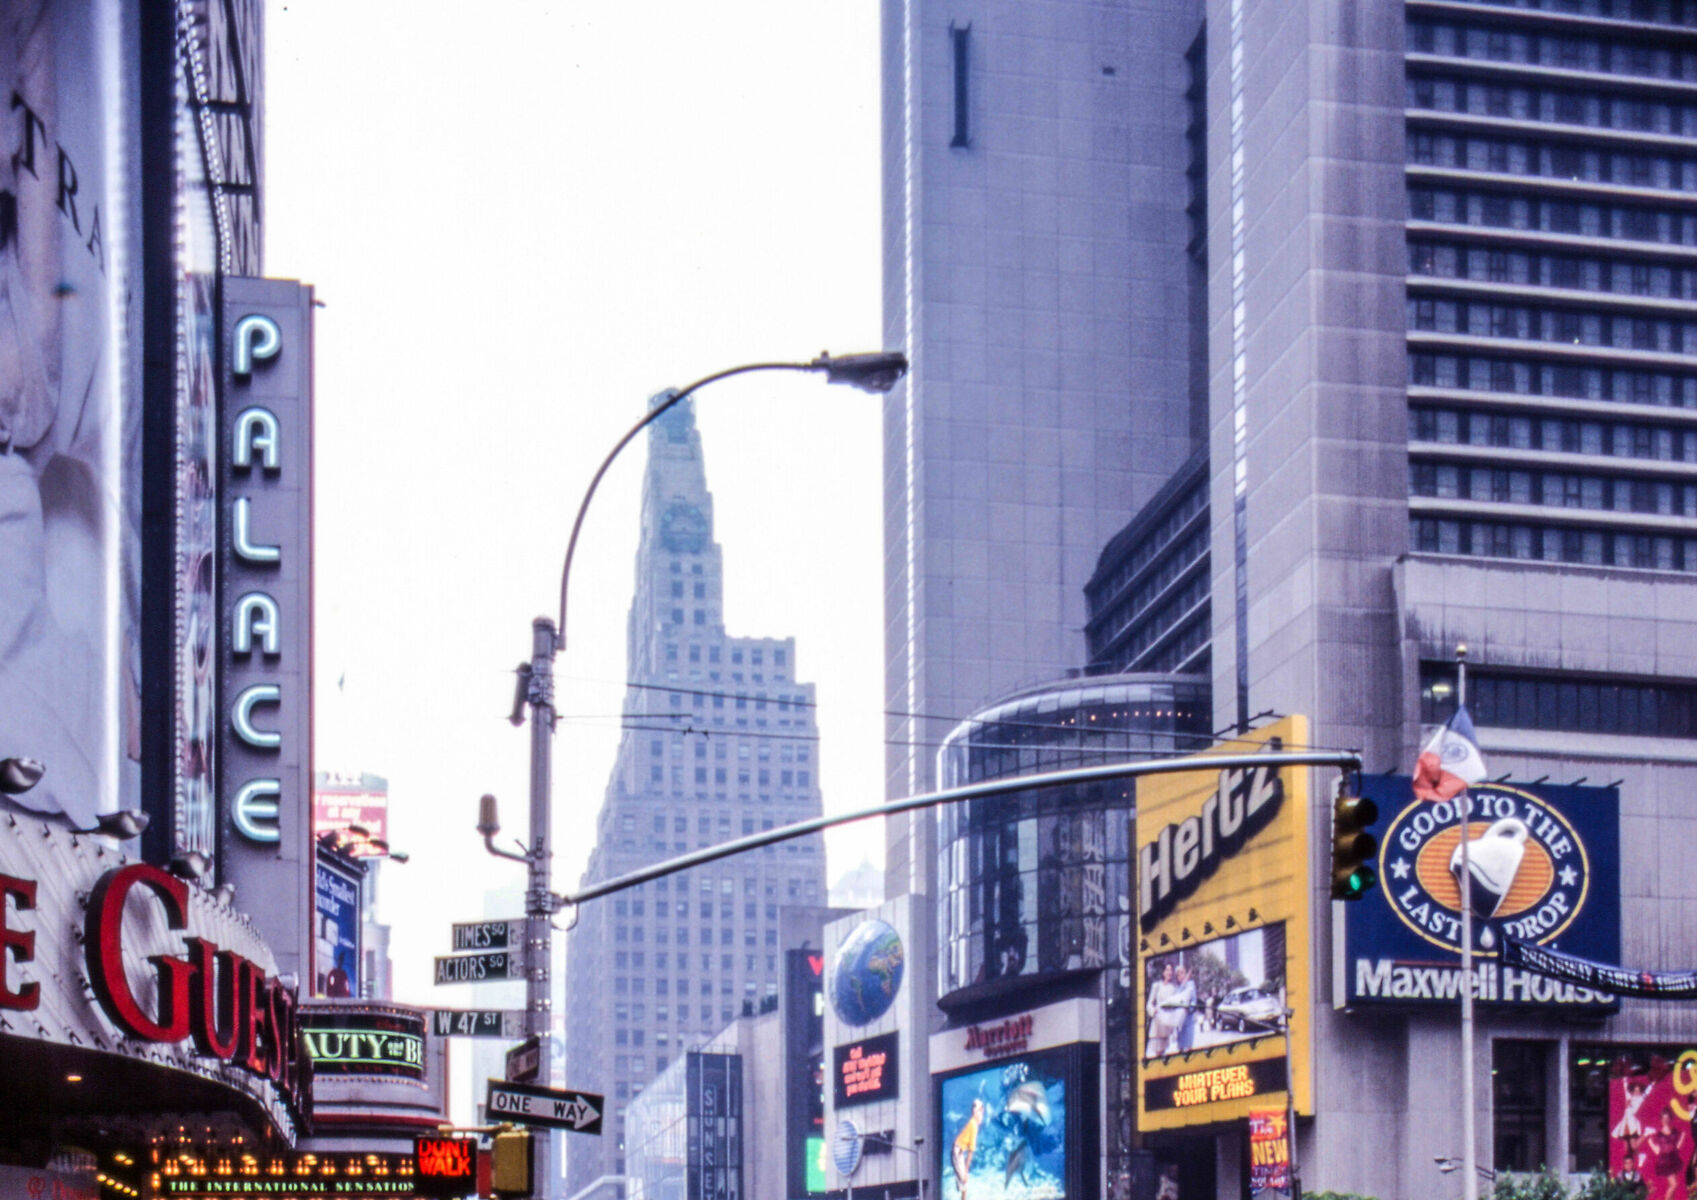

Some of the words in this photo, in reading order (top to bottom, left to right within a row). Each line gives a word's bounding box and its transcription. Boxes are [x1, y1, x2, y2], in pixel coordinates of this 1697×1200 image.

[232, 314, 283, 843] PALACE
[1140, 738, 1278, 919] Hertz
[1400, 796, 1474, 851] GOOD
[1477, 795, 1516, 817] TO
[1524, 804, 1572, 859] THE
[1399, 885, 1463, 940] LAST
[1503, 891, 1570, 939] DROP
[454, 924, 491, 948] TIMES
[492, 923, 505, 936] SQ
[437, 956, 486, 982] ACTORS
[489, 955, 504, 968] SQ
[439, 1013, 451, 1034] W
[458, 1012, 478, 1035] 47
[484, 1012, 498, 1025] ST
[1178, 1065, 1248, 1090] WHATEVER
[496, 1093, 532, 1113] ONE
[553, 1101, 588, 1121] WAY
[1173, 1087, 1207, 1107] YOUR
[1211, 1079, 1255, 1101] PLANS
[418, 1156, 471, 1176] WALK
[1251, 1138, 1288, 1166] NEW
[170, 1181, 199, 1192] THE
[207, 1181, 328, 1193] INTERNATIONAL
[335, 1181, 415, 1193] SENSATION
